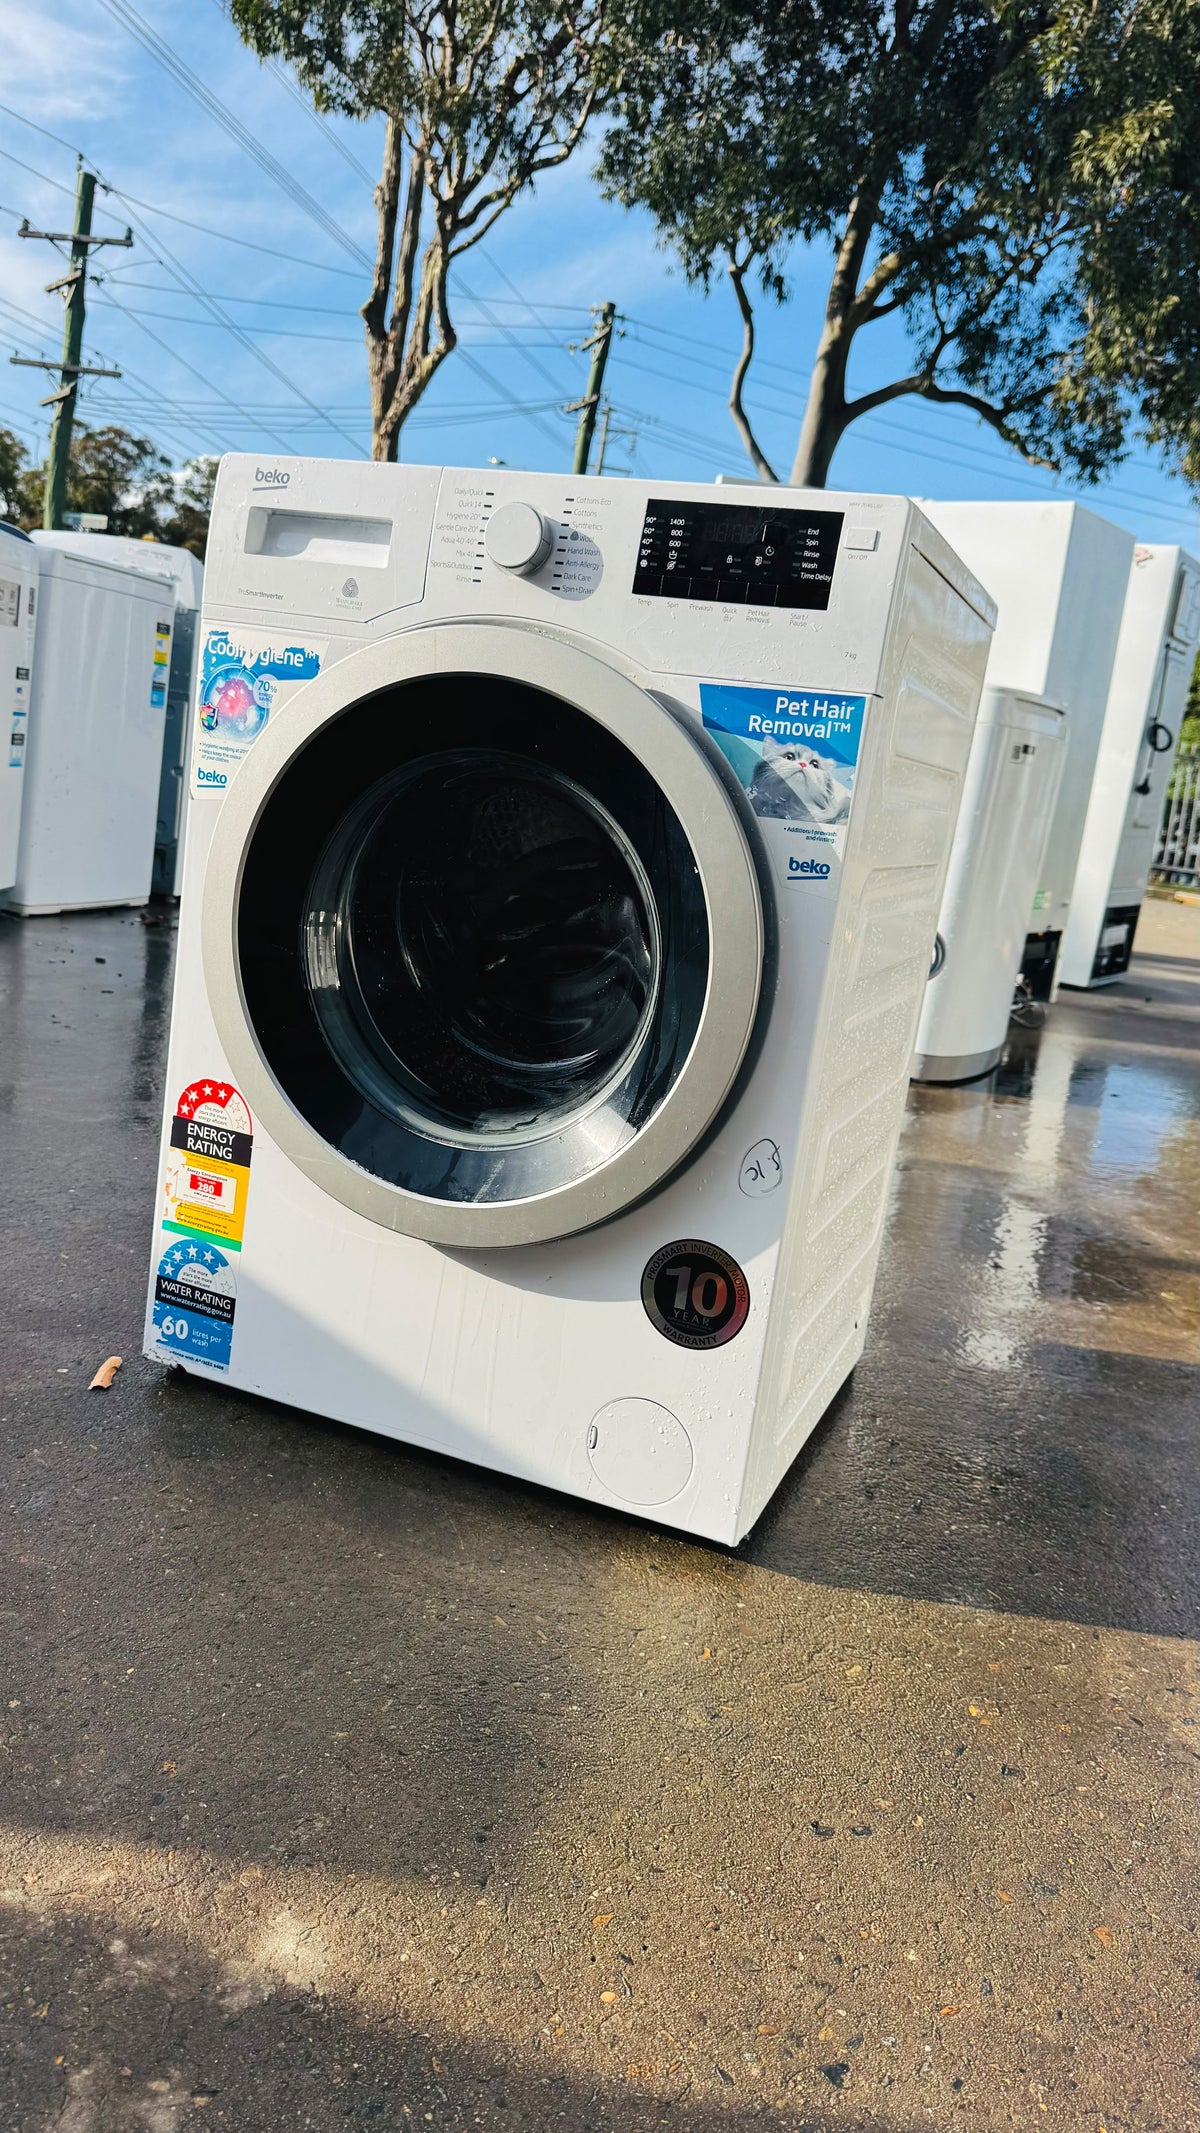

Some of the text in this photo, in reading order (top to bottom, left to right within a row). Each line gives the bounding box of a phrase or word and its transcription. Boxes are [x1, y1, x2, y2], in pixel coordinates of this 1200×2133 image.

[255, 467, 290, 484] beko
[576, 497, 599, 505] Cottons
[574, 509, 597, 517] Cottons
[572, 521, 603, 531] Synthetics
[807, 528, 820, 536] End
[669, 540, 682, 548] 600
[806, 539, 819, 547] Spin
[568, 548, 584, 556] Hand
[566, 560, 600, 571] Anti-Allergy
[564, 572, 592, 582] Dark Care
[801, 572, 832, 582] Time Delay
[638, 599, 653, 607] Temp
[667, 602, 680, 610] Spin
[690, 604, 714, 612] Prewash
[722, 607, 738, 615] Quick
[746, 616, 771, 624] Removal
[790, 620, 808, 628] Pause
[775, 697, 855, 721] Pet Hair
[748, 715, 851, 739] Removal™
[198, 767, 228, 785] beko
[789, 857, 831, 875] beko
[187, 1123, 236, 1146] ENERGY
[187, 1137, 233, 1160] RATING
[197, 1182, 215, 1194] 280
[647, 1244, 747, 1303] PROSMART INVERTER MOTOR
[161, 1279, 232, 1310] WATER RATING
[666, 1266, 728, 1318] 10
[160, 1291, 232, 1319] www.waterrating.gov.au
[674, 1309, 711, 1327] YEAR
[162, 1315, 189, 1340] 60
[192, 1328, 222, 1344] litres per
[663, 1324, 718, 1346] WARRANTY
[192, 1338, 209, 1347] wash
